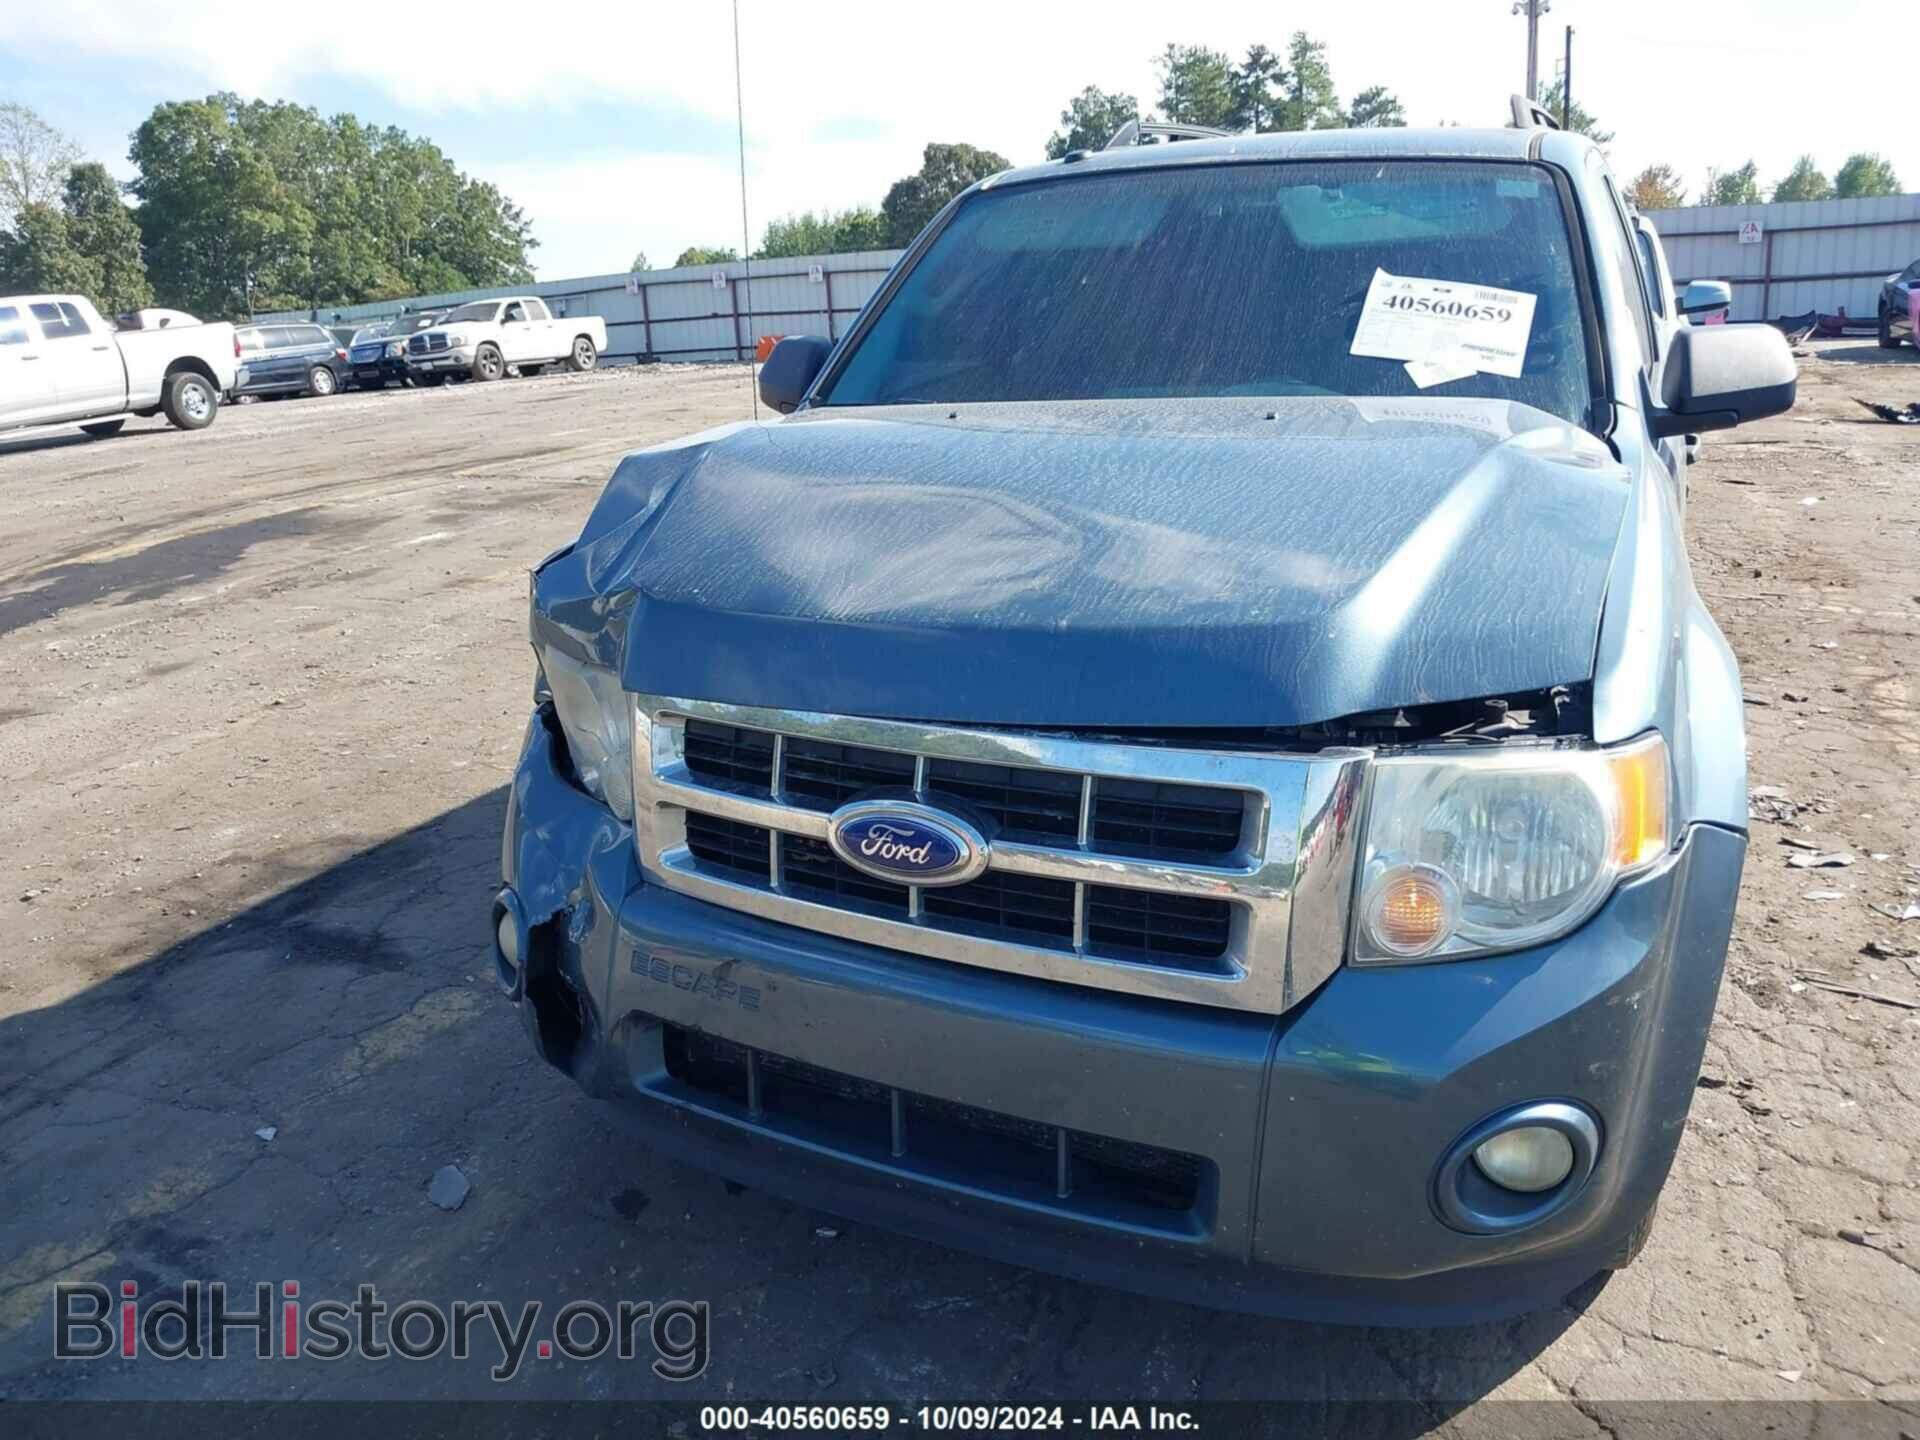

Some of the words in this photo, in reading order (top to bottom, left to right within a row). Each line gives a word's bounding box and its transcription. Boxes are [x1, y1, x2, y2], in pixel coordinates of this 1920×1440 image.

[1382, 295, 1512, 323] 40560659
[860, 823, 933, 865] Ford
[630, 949, 761, 1012] ESCAPE
